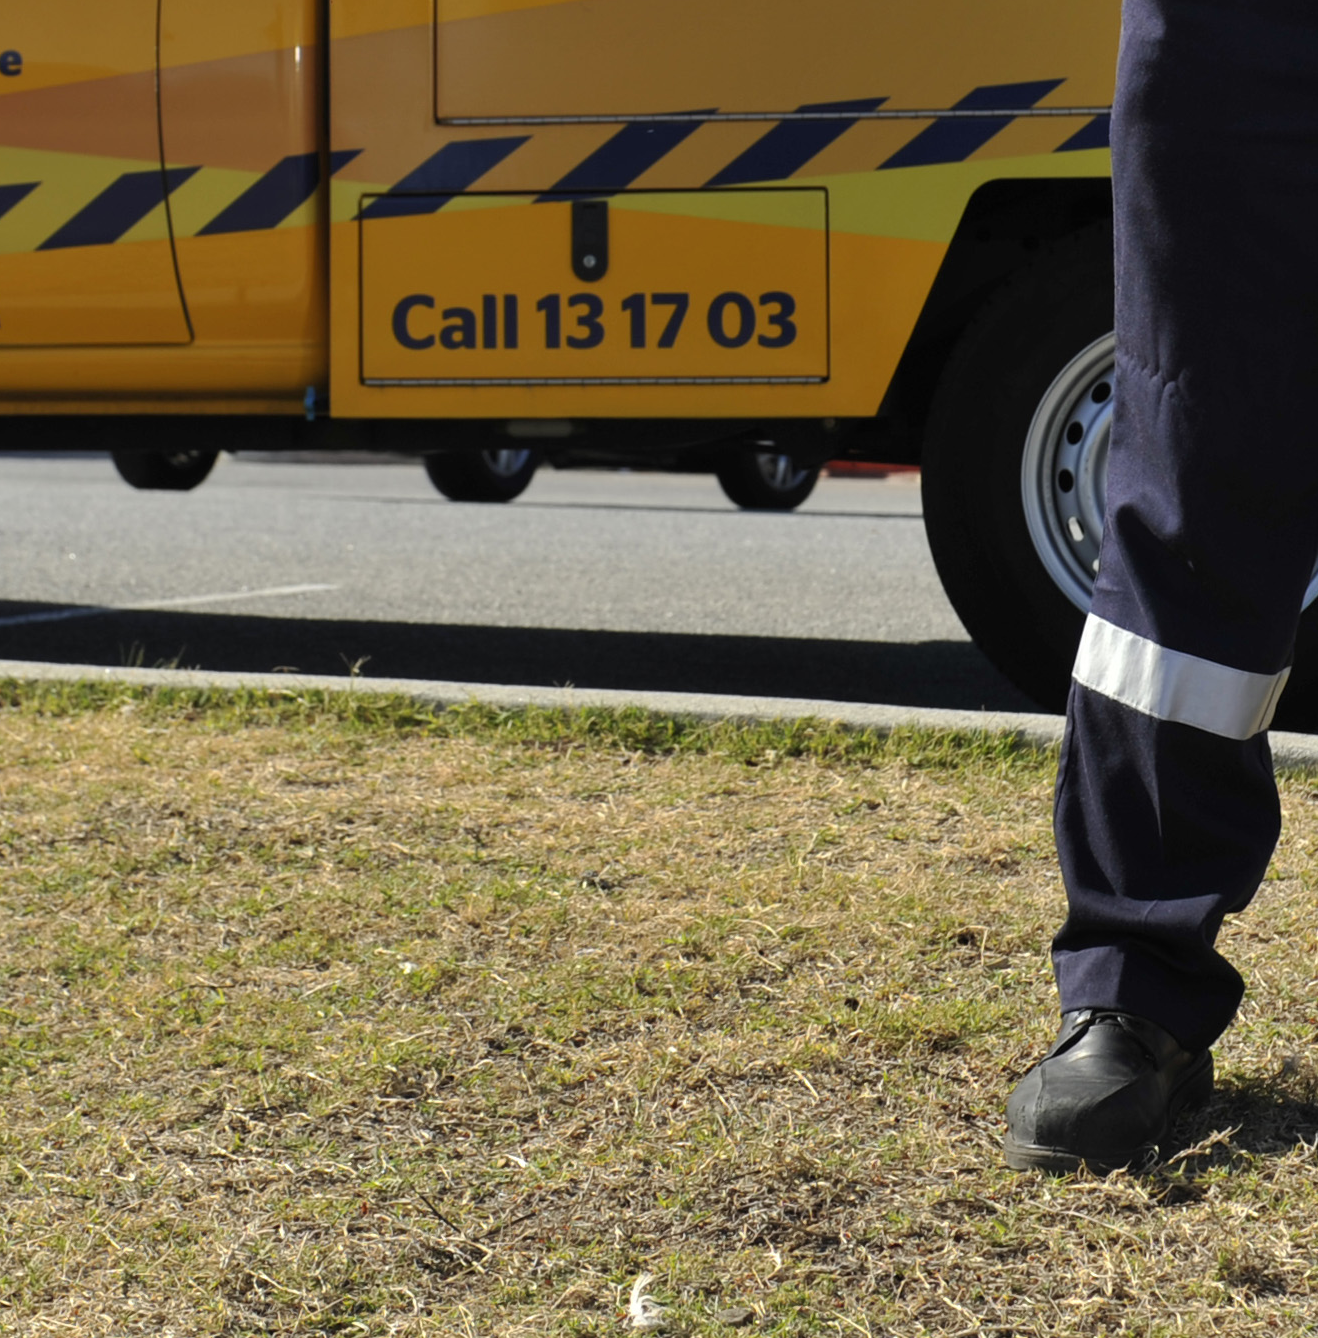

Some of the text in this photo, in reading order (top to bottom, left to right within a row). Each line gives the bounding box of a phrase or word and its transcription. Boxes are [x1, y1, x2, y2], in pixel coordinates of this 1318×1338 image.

[391, 292, 798, 350] Call 13 17 03
